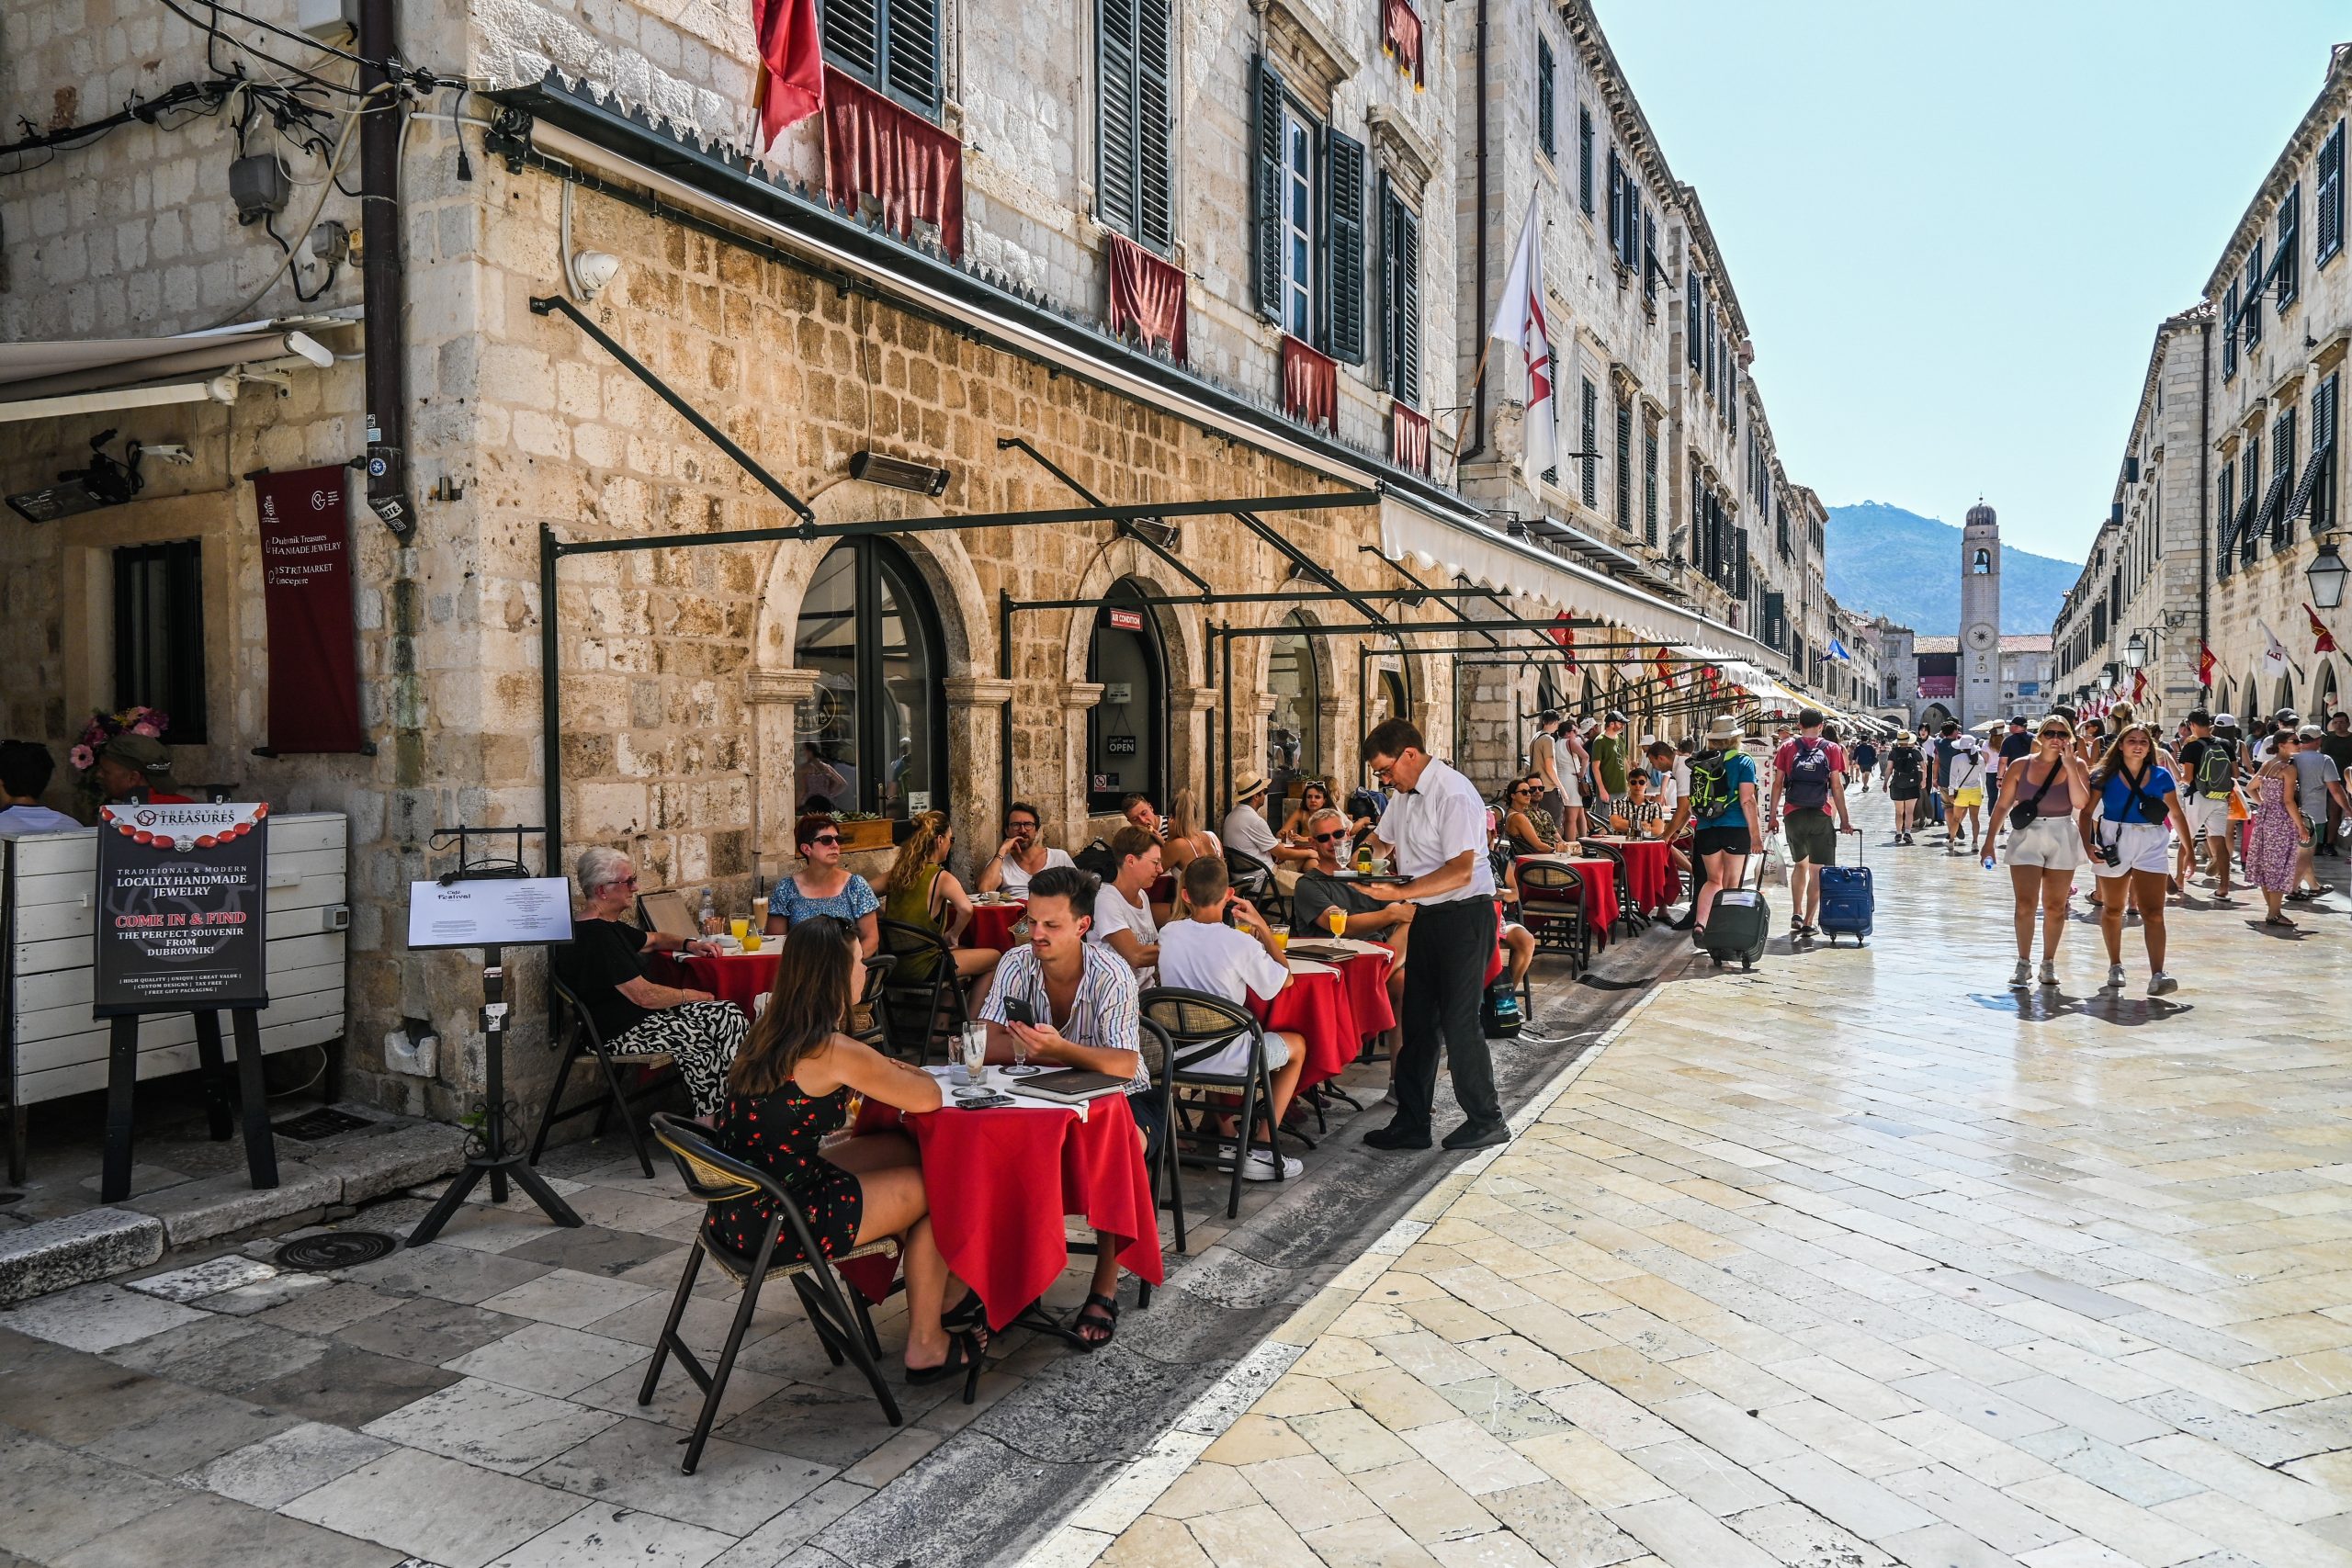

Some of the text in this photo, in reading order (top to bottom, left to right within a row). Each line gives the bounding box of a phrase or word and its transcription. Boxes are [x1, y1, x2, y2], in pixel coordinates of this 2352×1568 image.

[300, 535, 327, 544] Treasures
[311, 542, 342, 553] JEWELRY
[302, 563, 333, 574] MARKET
[1109, 743, 1135, 752] OPEN
[159, 813, 235, 824] TREASURES
[117, 867, 189, 875] TRADITIONAL
[205, 865, 247, 874] MODERN
[117, 874, 247, 887] LOCALLY HANDMADE
[153, 886, 211, 899] JEWELRY
[115, 911, 247, 928] COME IN & FIND
[117, 928, 244, 940] THE PERFECT SOUVENIR
[166, 938, 197, 947] FROM
[147, 946, 214, 956] DUBROVNIK!
